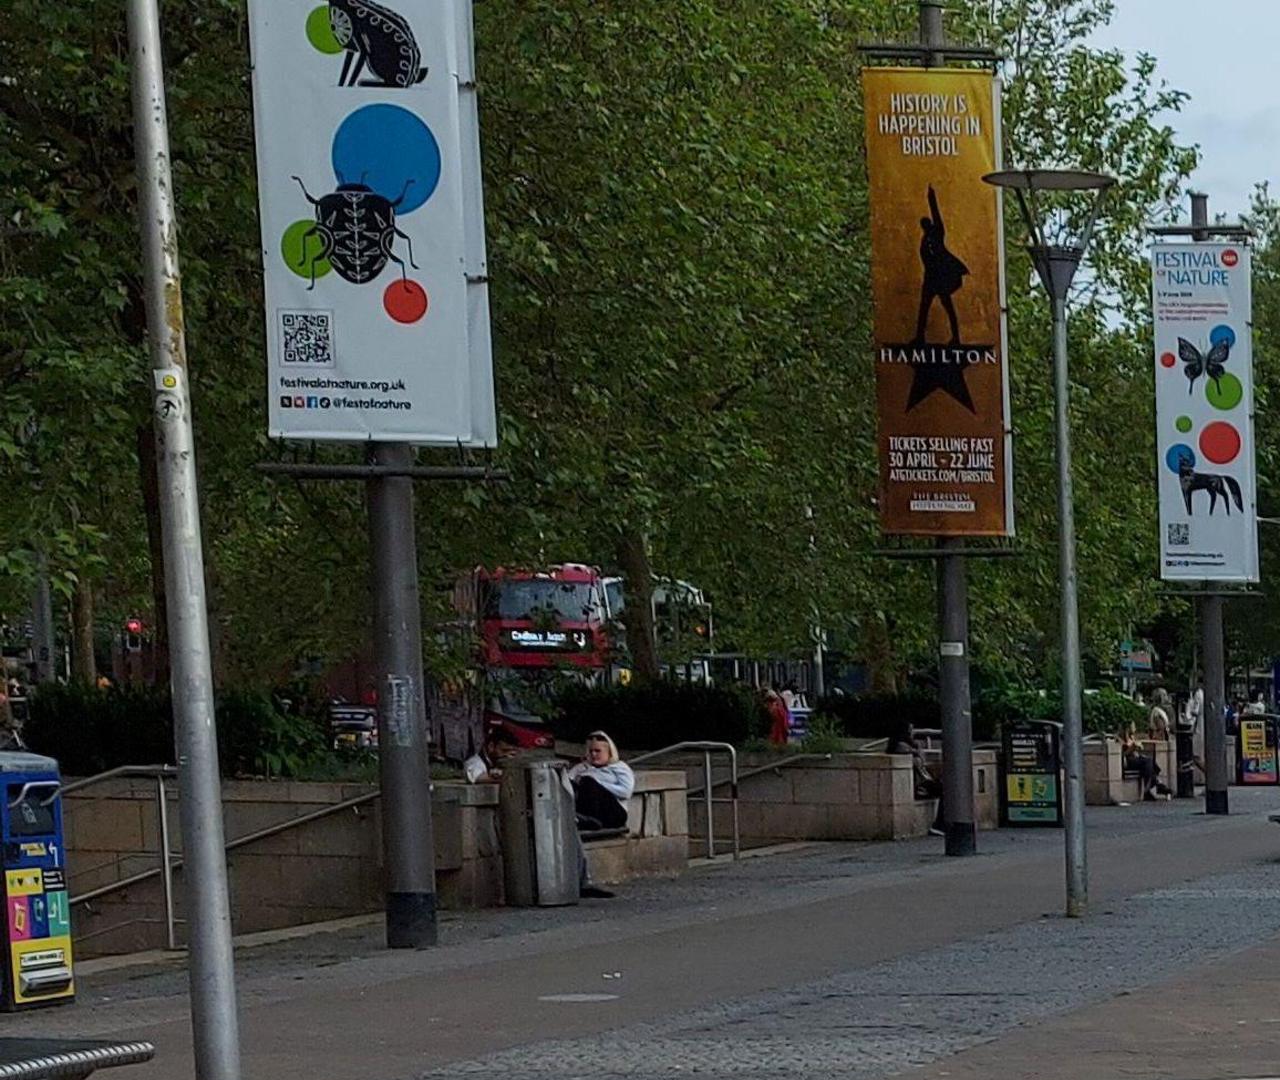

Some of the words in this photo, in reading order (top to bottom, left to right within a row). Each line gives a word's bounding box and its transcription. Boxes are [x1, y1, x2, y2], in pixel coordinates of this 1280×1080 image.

[890, 93, 949, 113] HISTORY
[953, 94, 968, 113] IS
[879, 114, 961, 135] HAPPENING
[965, 116, 981, 136] IN
[902, 136, 959, 156] BRISTOL
[1155, 252, 1220, 268] FESTIVAL
[1168, 270, 1229, 286] NATURE
[880, 348, 998, 365] HAMILTON
[889, 436, 928, 451] TICKETS
[928, 437, 968, 452] SELLING
[970, 438, 994, 453] FAST
[889, 452, 904, 467] 30
[906, 453, 938, 468] APRIL
[950, 453, 964, 468] 22
[966, 454, 995, 469] JUNE
[889, 469, 995, 483] ATGTICKETS.COM/BRISTOL
